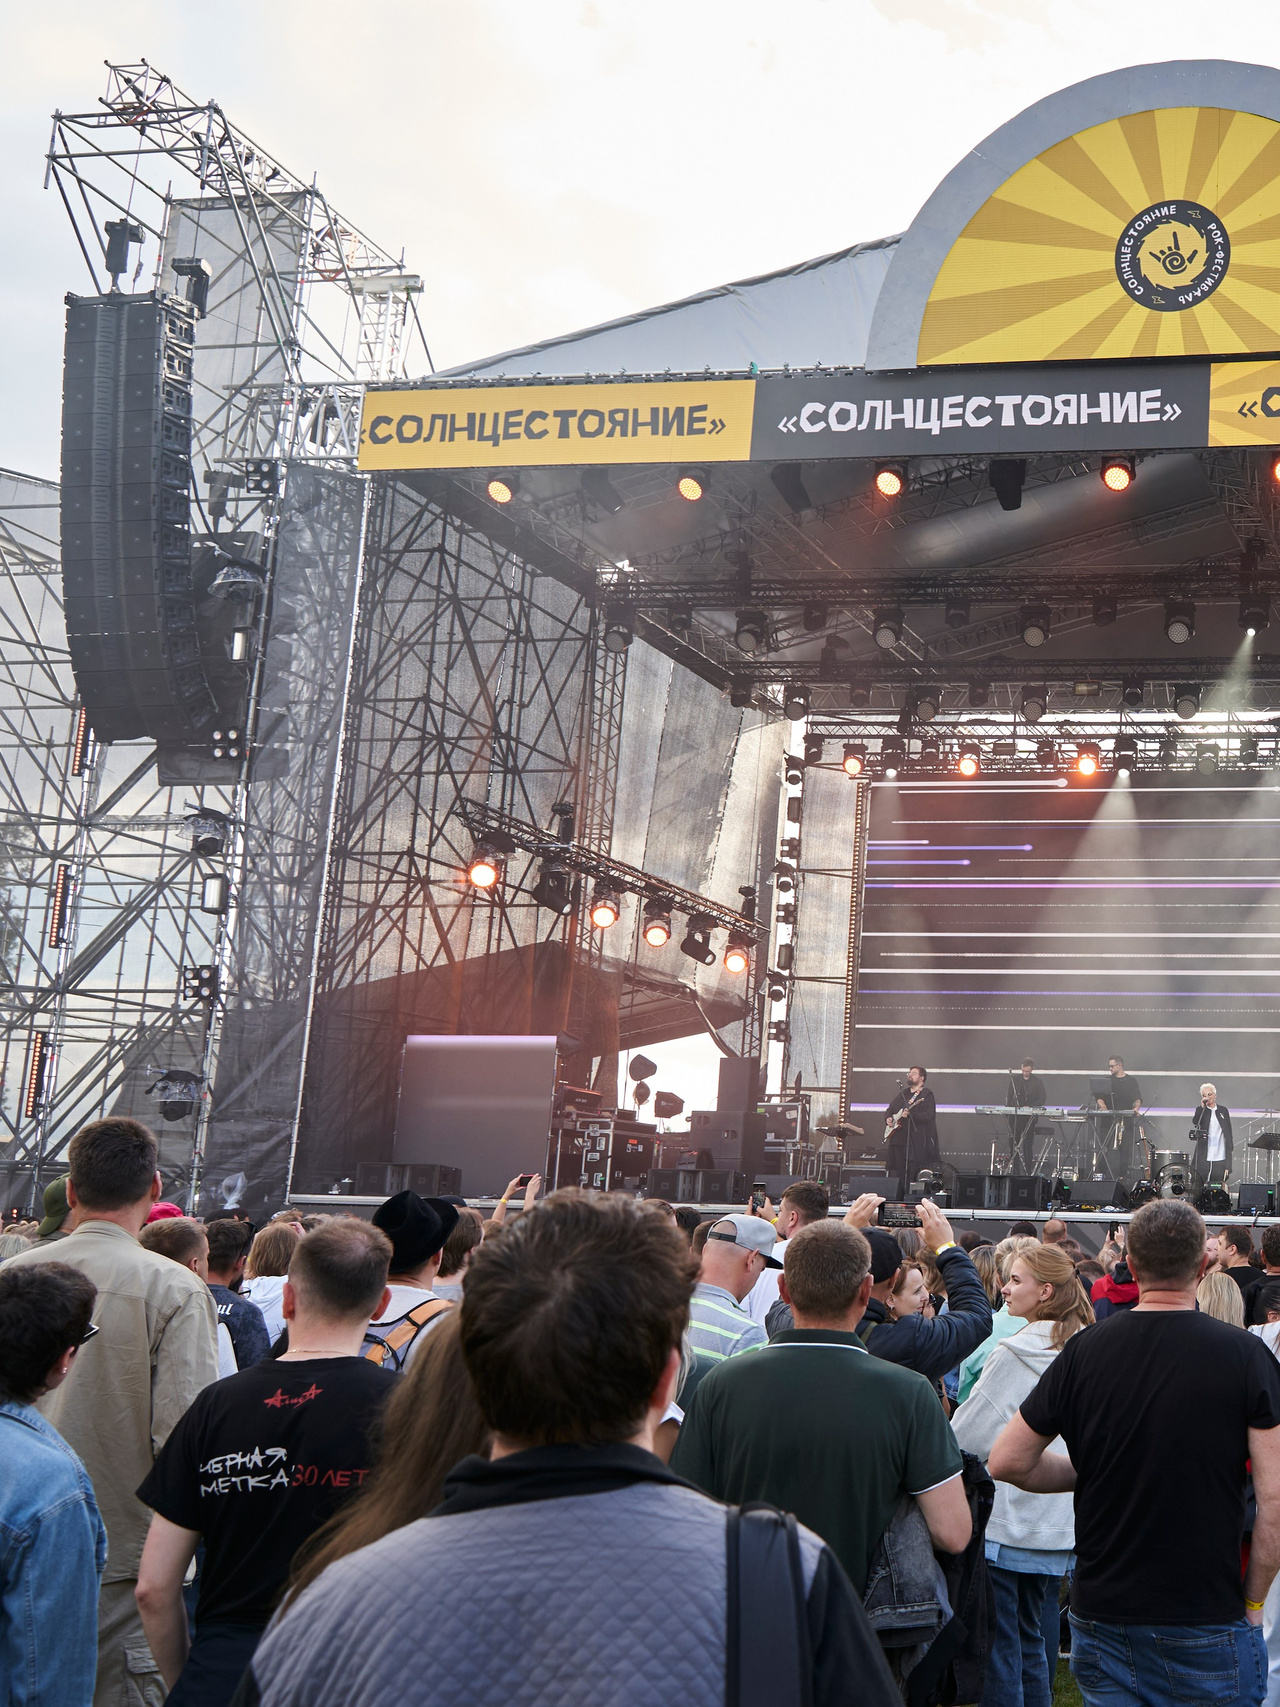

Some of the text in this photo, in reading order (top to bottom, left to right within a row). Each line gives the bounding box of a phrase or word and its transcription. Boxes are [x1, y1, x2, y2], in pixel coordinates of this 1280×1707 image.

[1120, 204, 1177, 296] СОЛНЦЕСТОЯНИЕ
[1178, 222, 1225, 305] РОК-ФЕСТИВАЛЬ
[777, 388, 1183, 436] «СОЛНЦЕСТОЯНИЕ»
[200, 1445, 288, 1475] ЧЕРНАЯ
[321, 1468, 370, 1488] ЛЕТ
